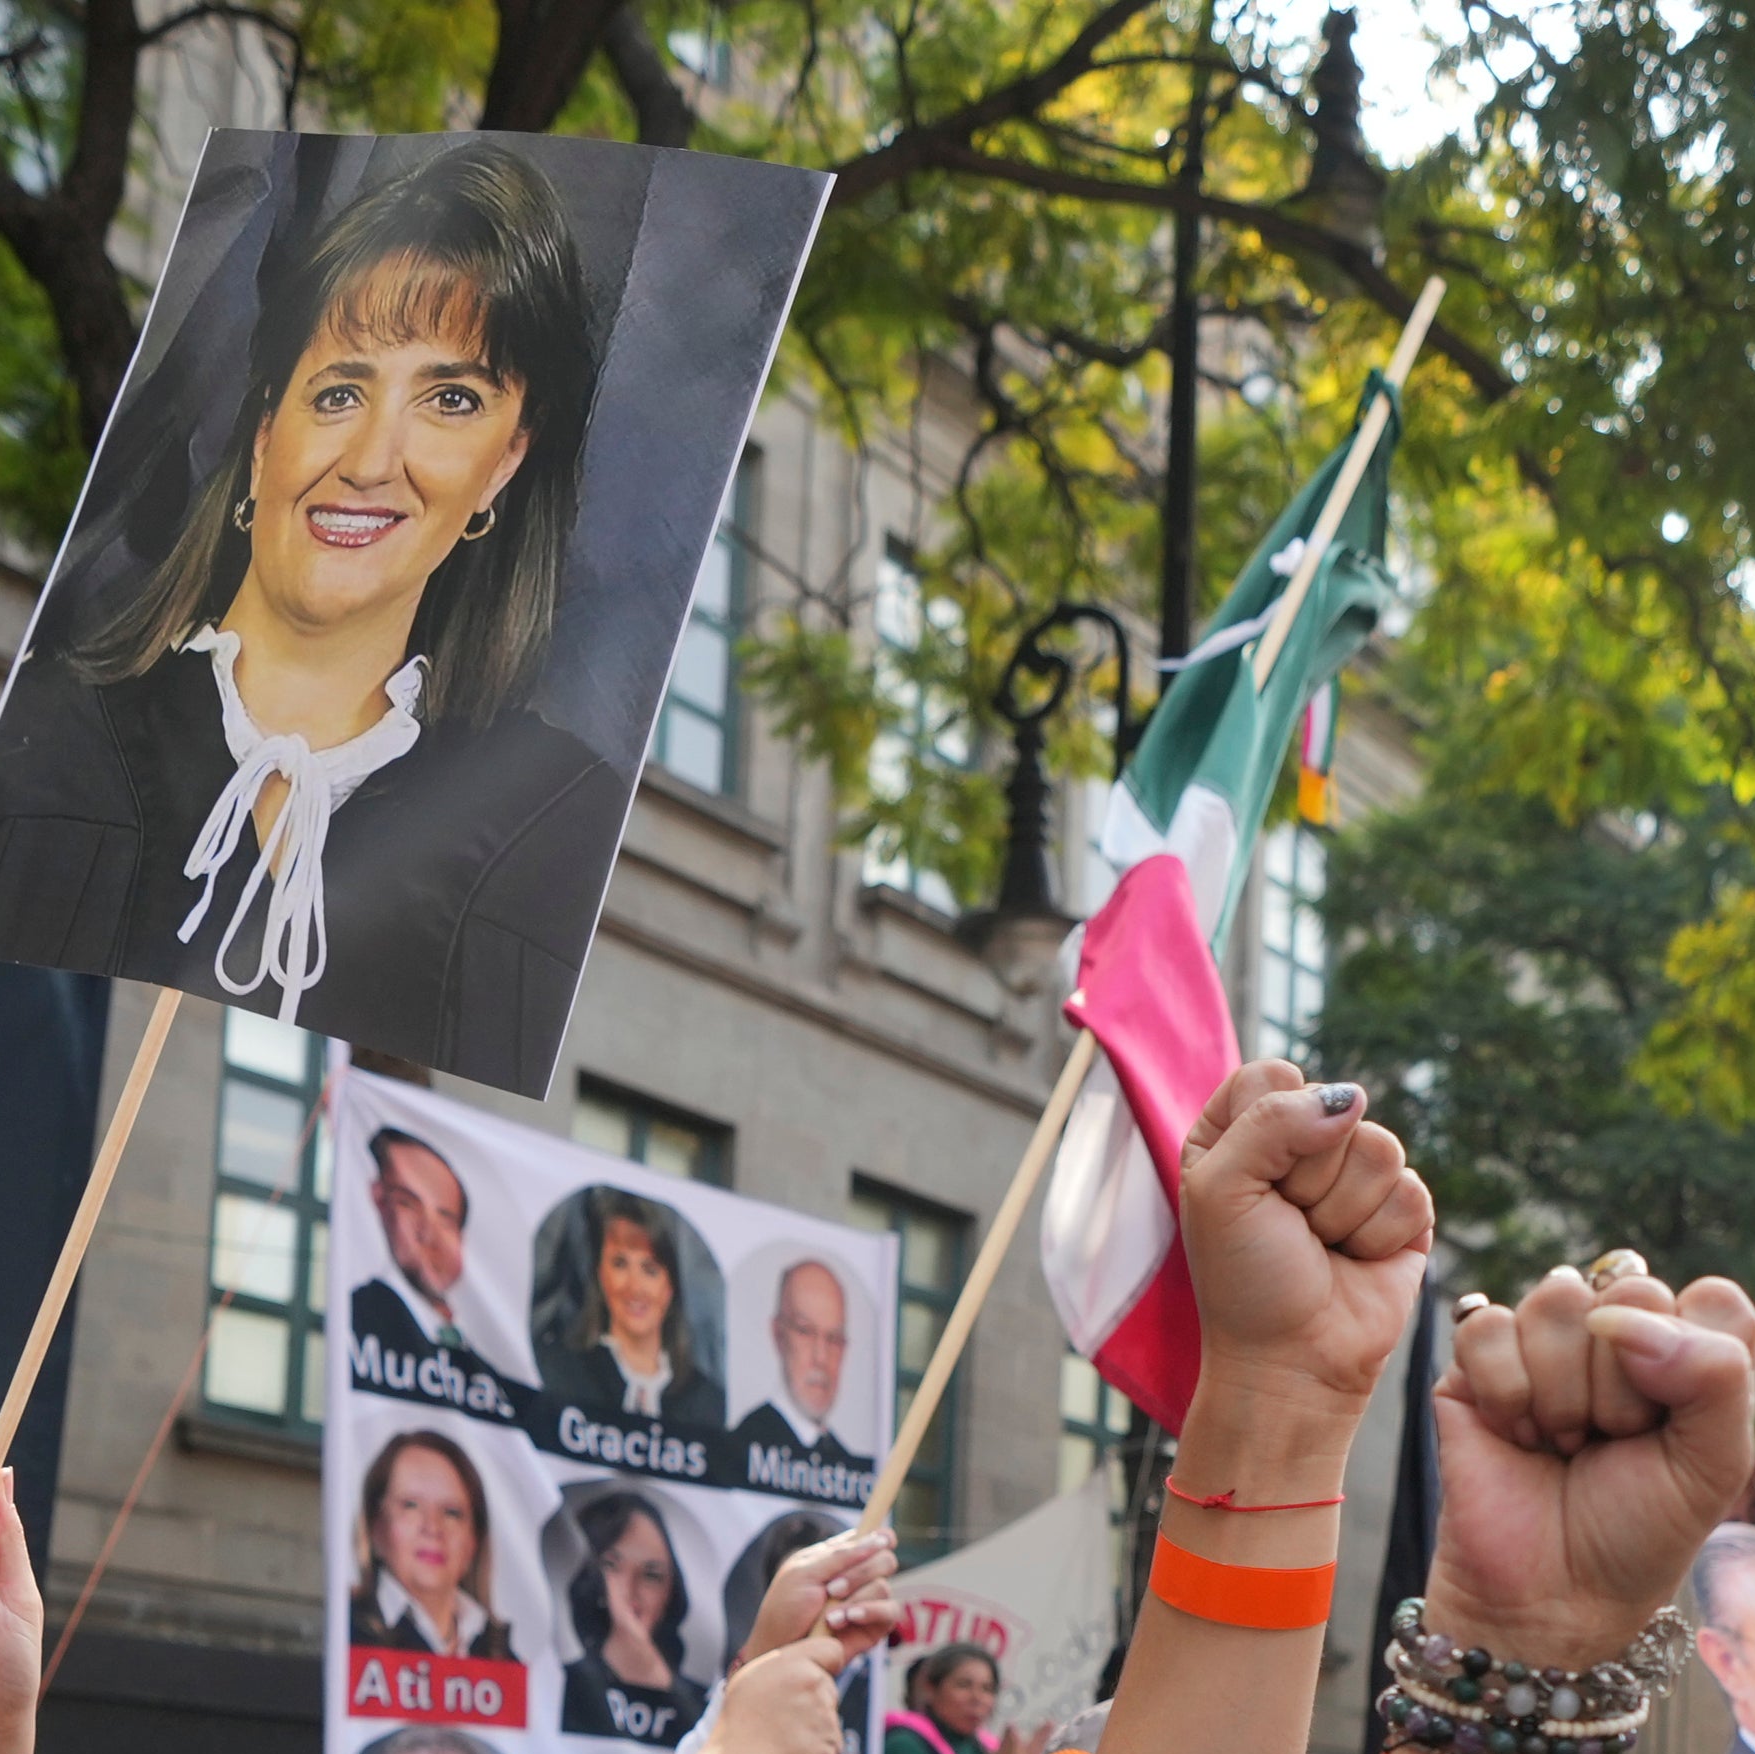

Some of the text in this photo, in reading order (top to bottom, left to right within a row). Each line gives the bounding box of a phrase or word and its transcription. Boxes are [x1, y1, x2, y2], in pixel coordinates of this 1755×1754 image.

[558, 1405, 707, 1478] Gracias
[354, 1658, 503, 1717] A ti no
